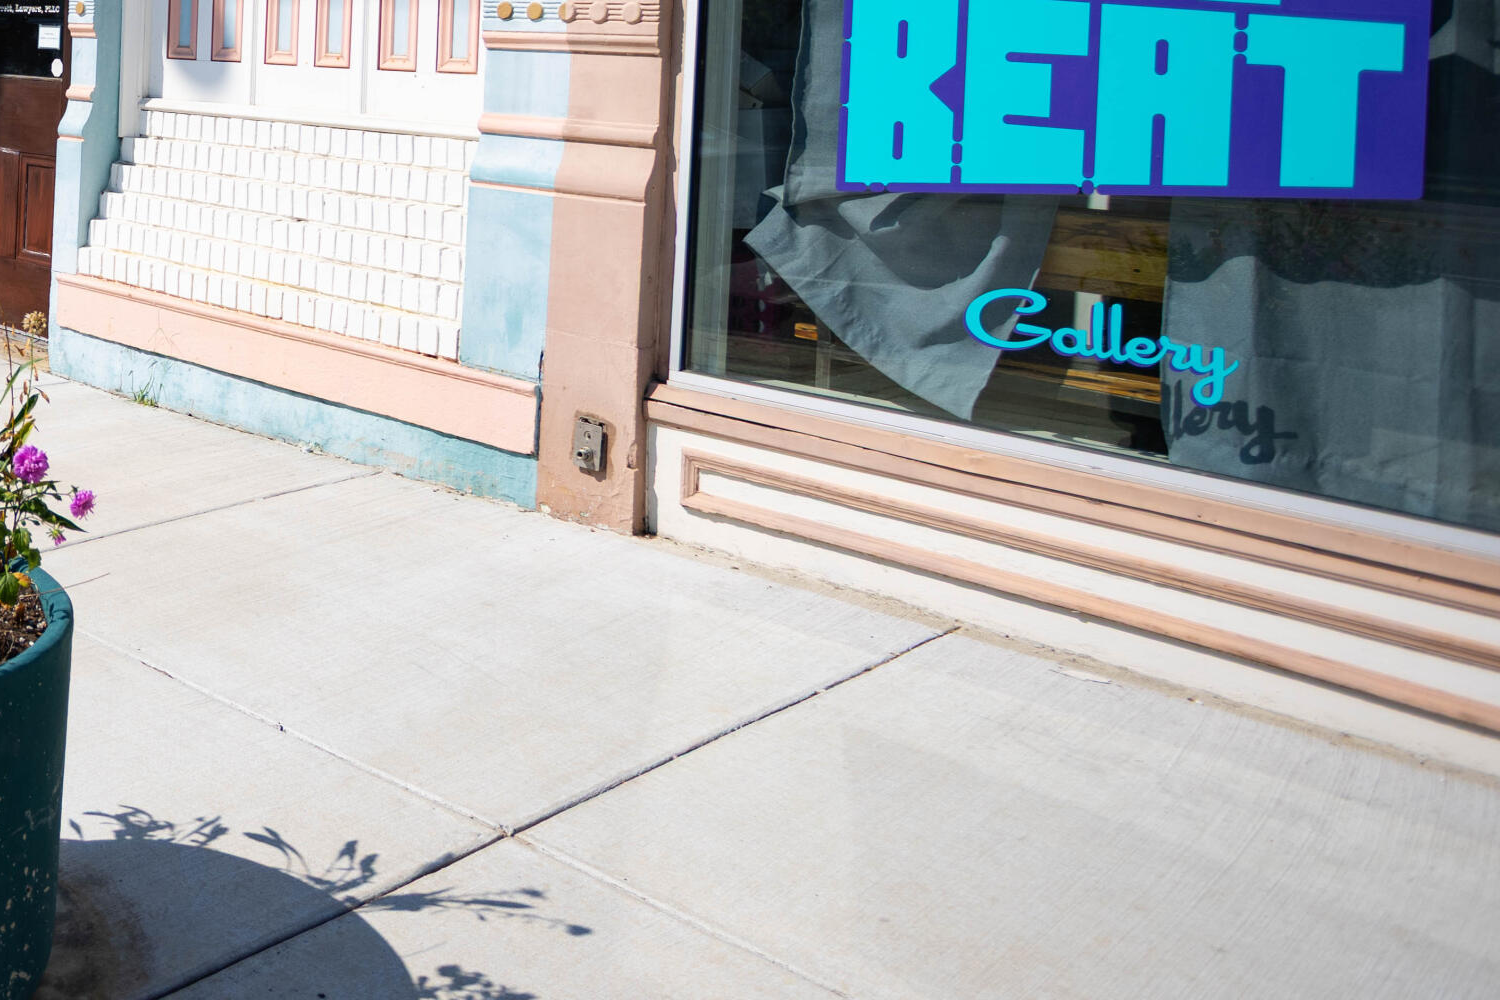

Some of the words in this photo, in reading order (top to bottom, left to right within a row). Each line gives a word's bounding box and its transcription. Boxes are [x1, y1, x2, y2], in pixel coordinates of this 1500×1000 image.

[15, 3, 44, 15] Lawyers,
[44, 4, 60, 14] PLLC
[963, 287, 1240, 408] Gallery
